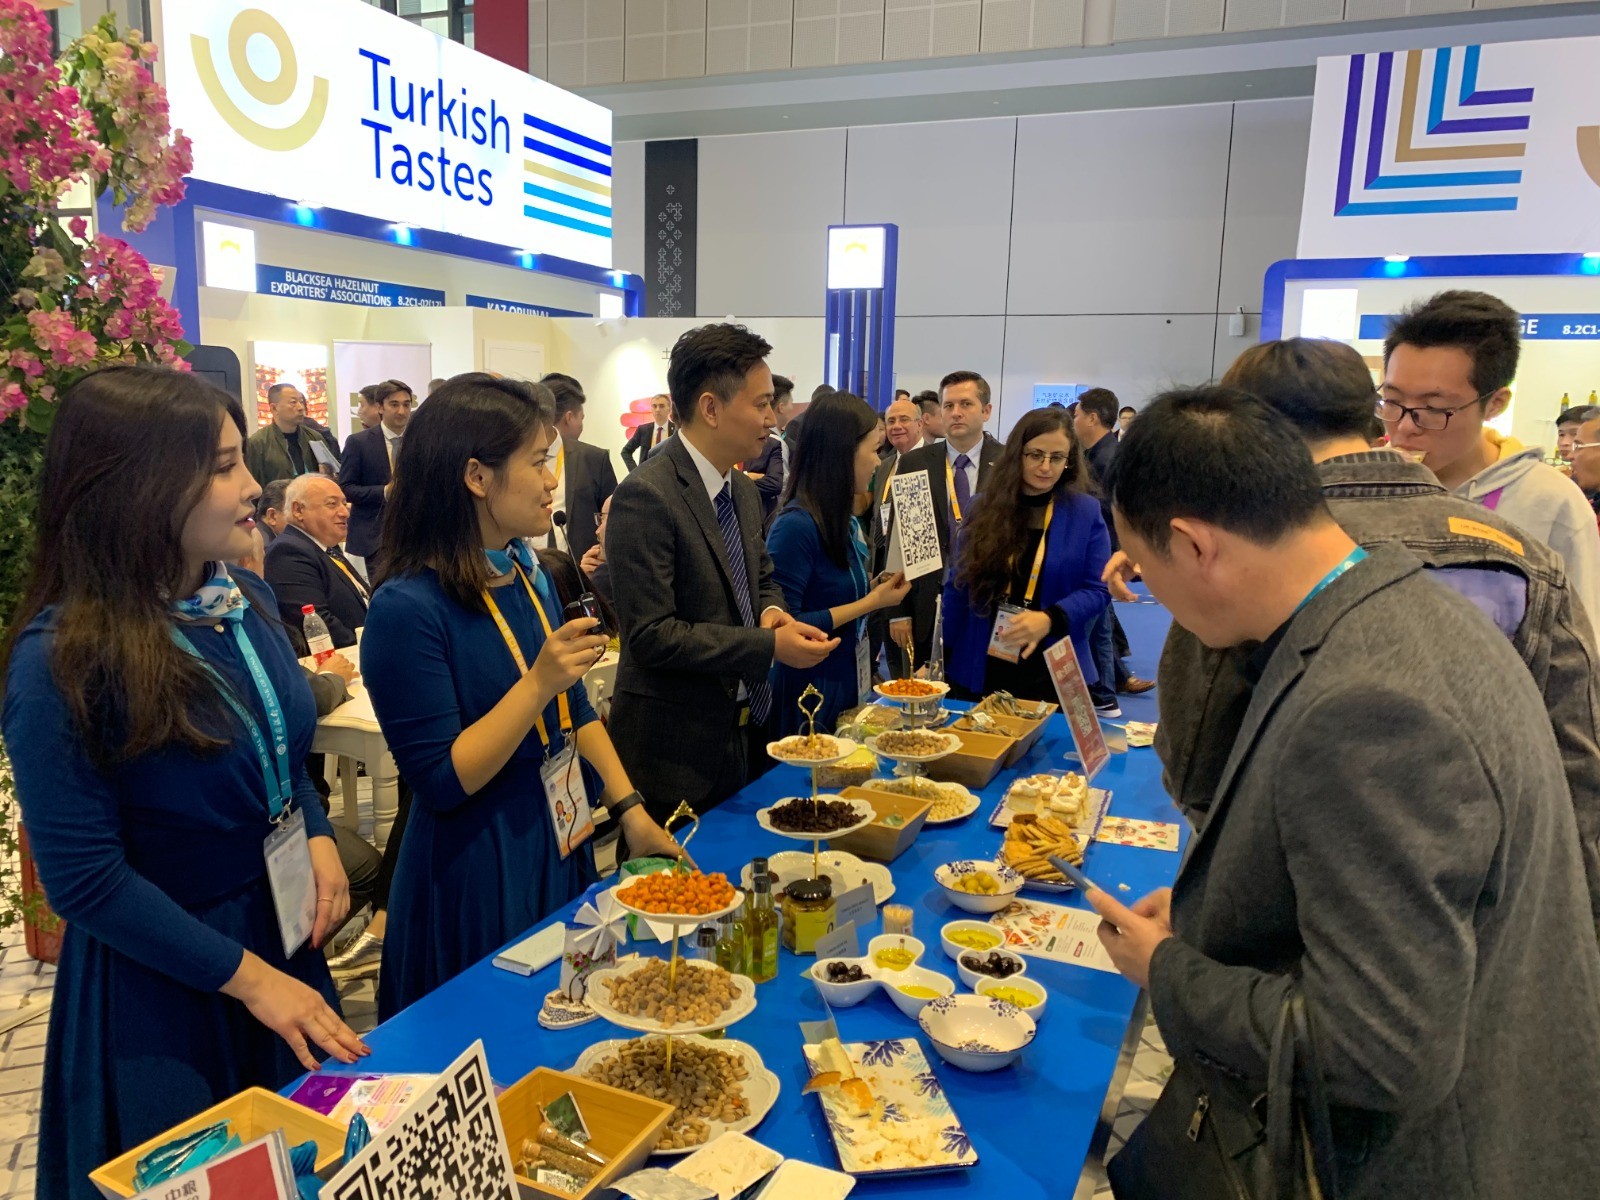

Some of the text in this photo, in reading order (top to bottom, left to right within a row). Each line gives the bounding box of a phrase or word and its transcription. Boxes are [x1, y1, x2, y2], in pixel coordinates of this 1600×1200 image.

[359, 47, 510, 154] Turkish
[361, 117, 493, 206] Tastes
[270, 281, 328, 299] EXPORTERS'
[330, 289, 392, 307] ASSOCIATIONS
[285, 270, 379, 294] BLACKSEA HAZELNUT
